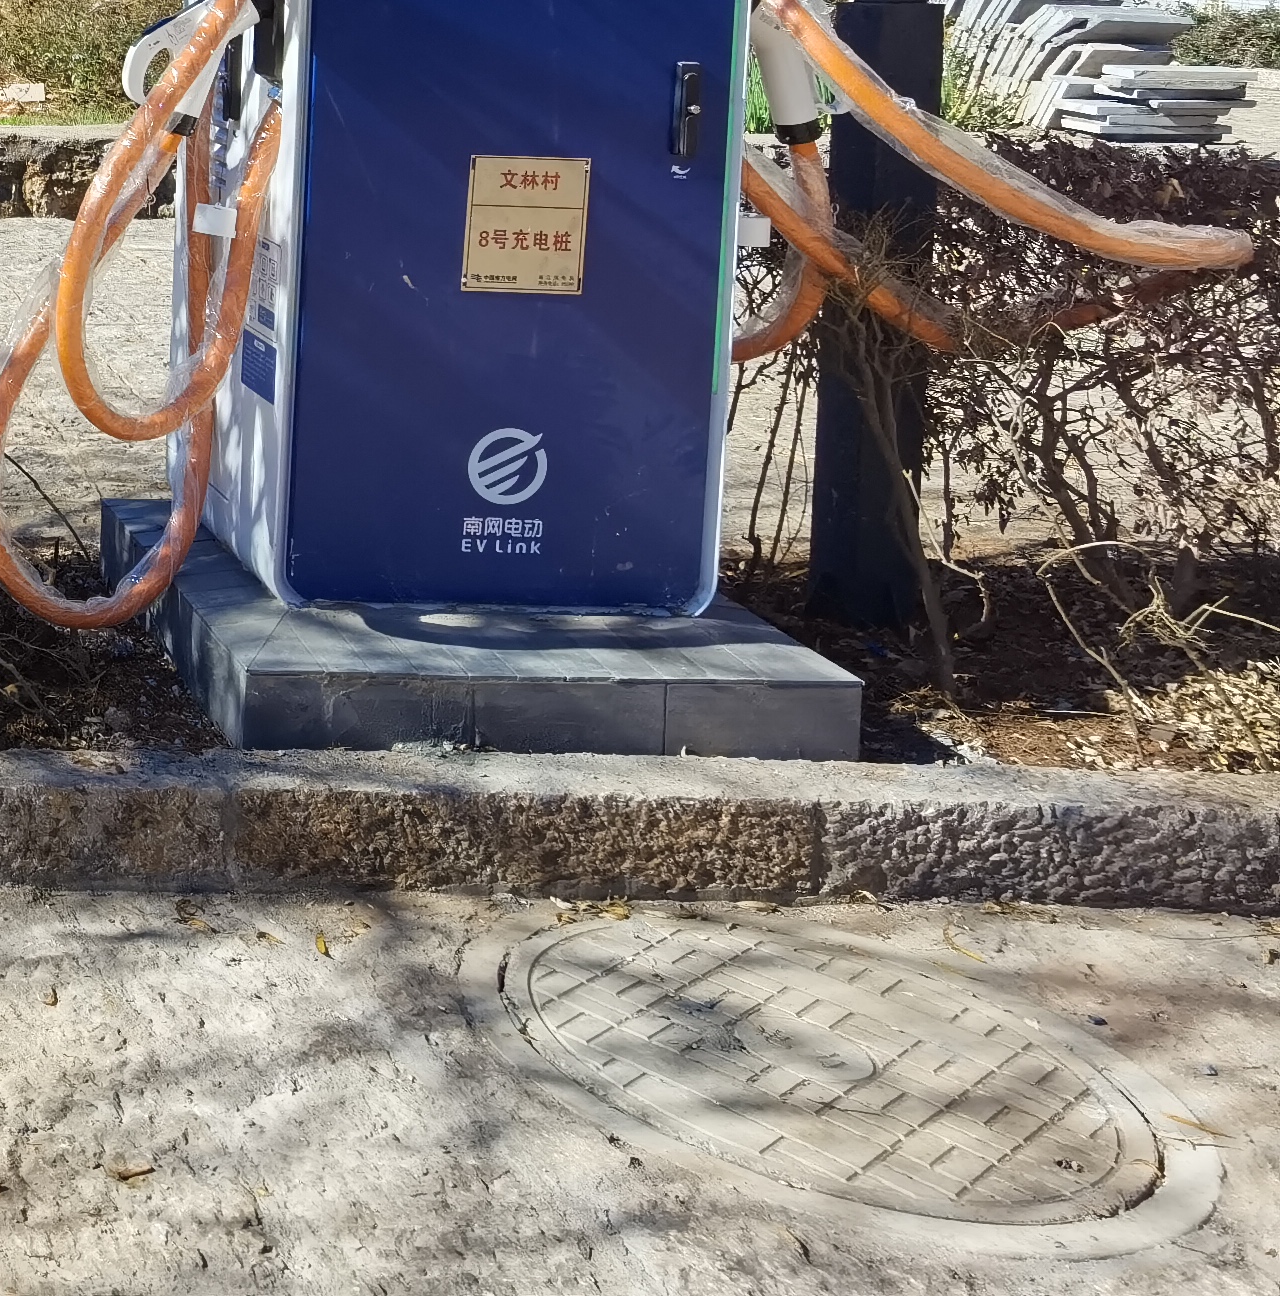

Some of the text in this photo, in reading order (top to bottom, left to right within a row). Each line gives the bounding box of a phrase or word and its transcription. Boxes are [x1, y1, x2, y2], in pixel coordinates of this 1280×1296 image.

[500, 169, 561, 191] 文林村
[478, 229, 572, 252] 8号充电桩
[462, 516, 543, 538] 南网电动
[461, 538, 541, 554] EV Link
